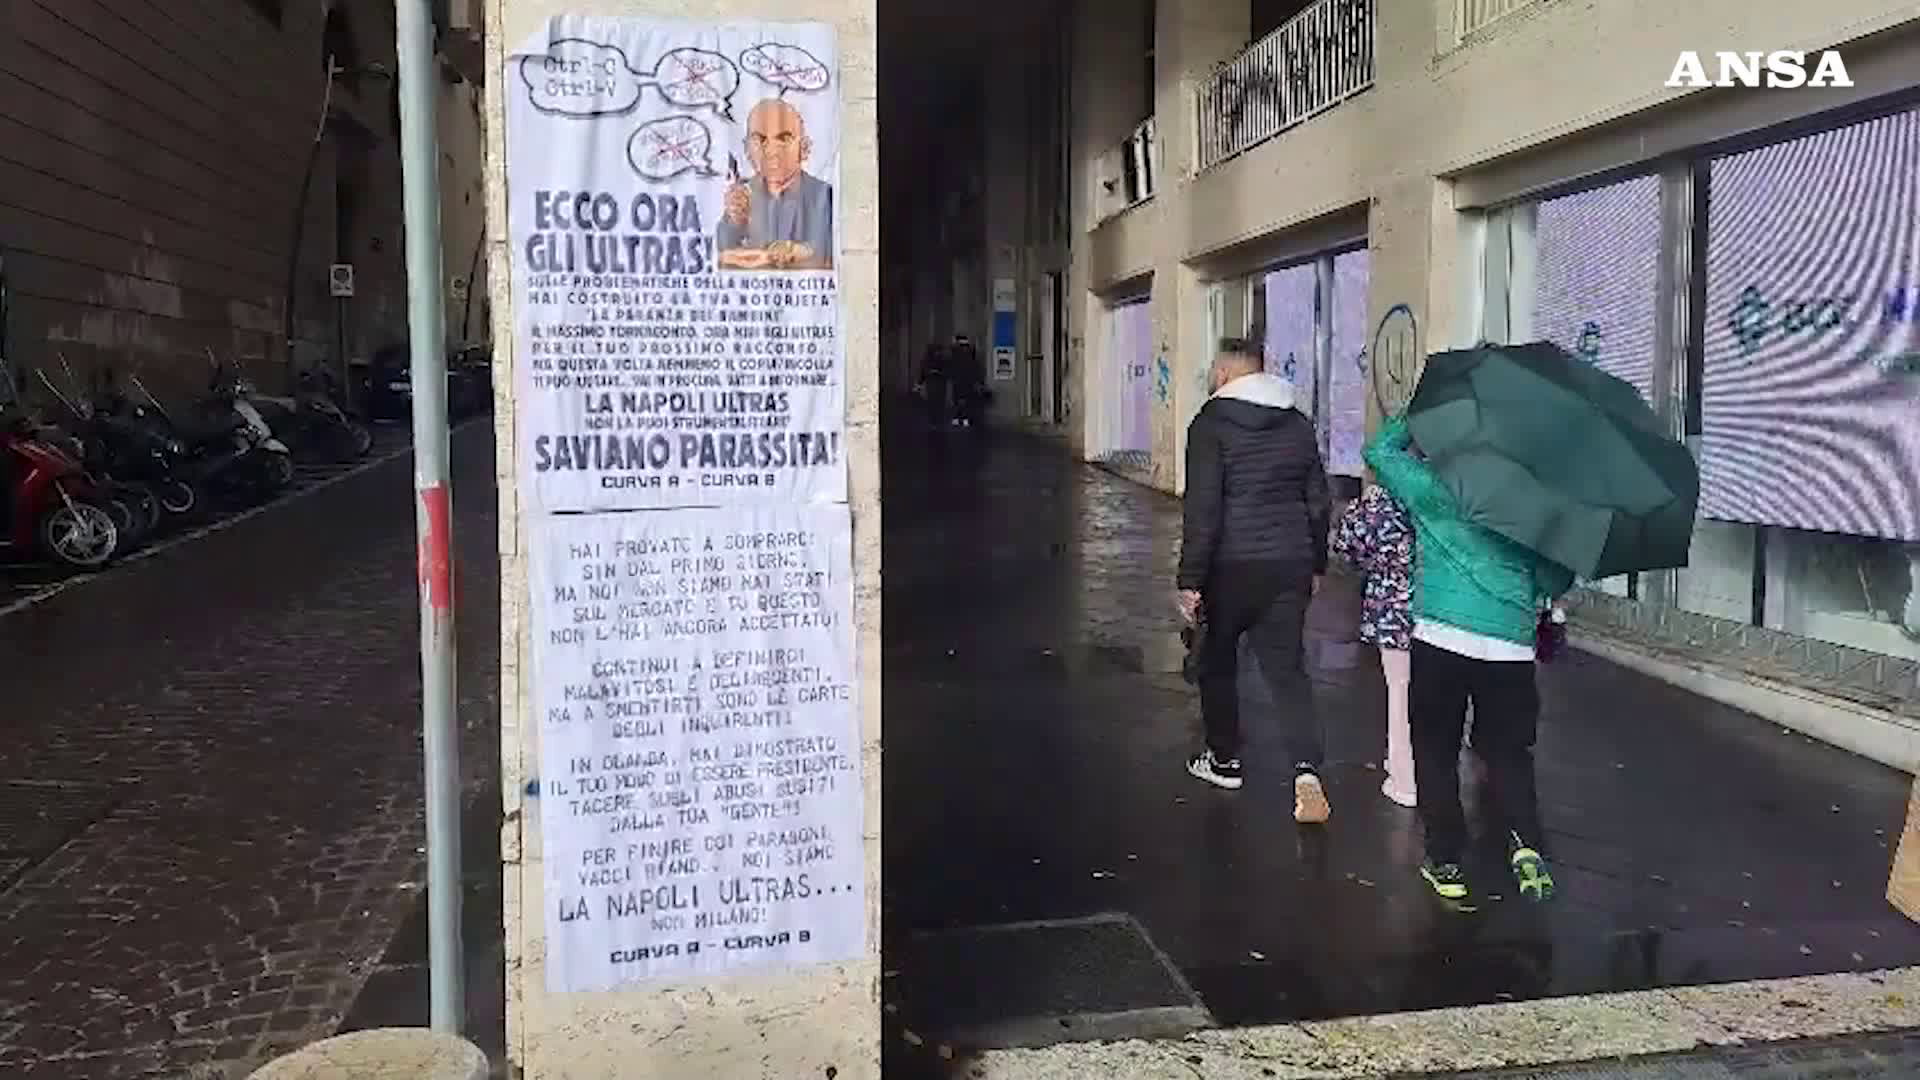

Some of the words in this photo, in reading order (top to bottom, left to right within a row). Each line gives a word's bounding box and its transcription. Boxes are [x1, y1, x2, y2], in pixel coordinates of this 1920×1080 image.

[535, 191, 618, 232] ECCO
[631, 193, 701, 233] ORA
[526, 235, 574, 273] GLI
[585, 234, 713, 273] ULTRAS!
[694, 277, 735, 288] DELLA
[742, 278, 792, 289] NOSTRA
[528, 291, 557, 304] HAI
[568, 291, 663, 305] COSTRUITO
[700, 293, 729, 305] TUA
[546, 325, 605, 338] MASSIMO
[532, 342, 561, 354] PER
[596, 342, 629, 354] TUO
[640, 342, 725, 354] PROSSIMO
[558, 359, 608, 371] QUESTA
[613, 359, 652, 370] VOLTA
[585, 392, 612, 413] LA
[621, 392, 704, 413] NAPOLI
[713, 392, 790, 413] ULTRAS
[585, 416, 613, 429] NON
[535, 434, 670, 472] SAVIANO
[680, 432, 838, 469] PARASSITA!
[602, 476, 660, 488] CURVA
[669, 476, 679, 488] A
[701, 474, 758, 486] CURVA
[765, 474, 775, 486] B
[570, 543, 600, 559] HAI
[615, 537, 691, 557] PROVATO
[704, 536, 713, 551] A
[583, 563, 616, 581] SIN
[627, 560, 660, 577] DAL
[671, 556, 724, 574] PRIMO
[554, 585, 576, 603] MA
[589, 584, 618, 601] NOI
[678, 575, 731, 595] SIAMO
[741, 574, 770, 591] MAI
[573, 604, 606, 623] SUL
[618, 600, 693, 619] MERCATO
[728, 595, 748, 611] TU
[758, 591, 820, 612] QUESTO
[551, 628, 584, 645] NON
[665, 618, 727, 636] ANCORA
[592, 657, 678, 677] CONTINUI
[693, 657, 702, 673] A
[564, 678, 673, 701] MALAVITOSI
[549, 706, 570, 722] MA
[584, 705, 594, 721] A
[606, 697, 700, 719] SMENTIRTI
[717, 690, 757, 709] SONO
[768, 688, 788, 705] LE
[798, 685, 849, 703] CARTE
[613, 719, 664, 738] DEGLI
[571, 757, 591, 774] IN
[690, 746, 719, 762] HAI
[734, 736, 836, 758] DIMOSTRATO
[551, 779, 568, 796] IL
[576, 776, 606, 794] TUO
[615, 771, 655, 790] MODO
[665, 771, 681, 786] DI
[692, 763, 750, 782] ESSERE
[714, 783, 763, 801] ABUSI
[610, 813, 664, 833] DALLA
[678, 808, 709, 825] TUA
[583, 848, 616, 866] PER
[628, 838, 693, 860] FINIRE
[705, 834, 733, 851] COI
[578, 866, 630, 886] VACCI
[742, 851, 770, 868] NOI
[784, 845, 833, 866] SIAMO
[560, 896, 590, 921] LA
[607, 884, 698, 920] NAPOLI
[652, 915, 684, 931] NON
[695, 907, 767, 928] MILANO!
[610, 943, 679, 964] CURVA
[687, 941, 699, 955] A
[724, 931, 790, 950] CURVA
[799, 930, 811, 943] B
